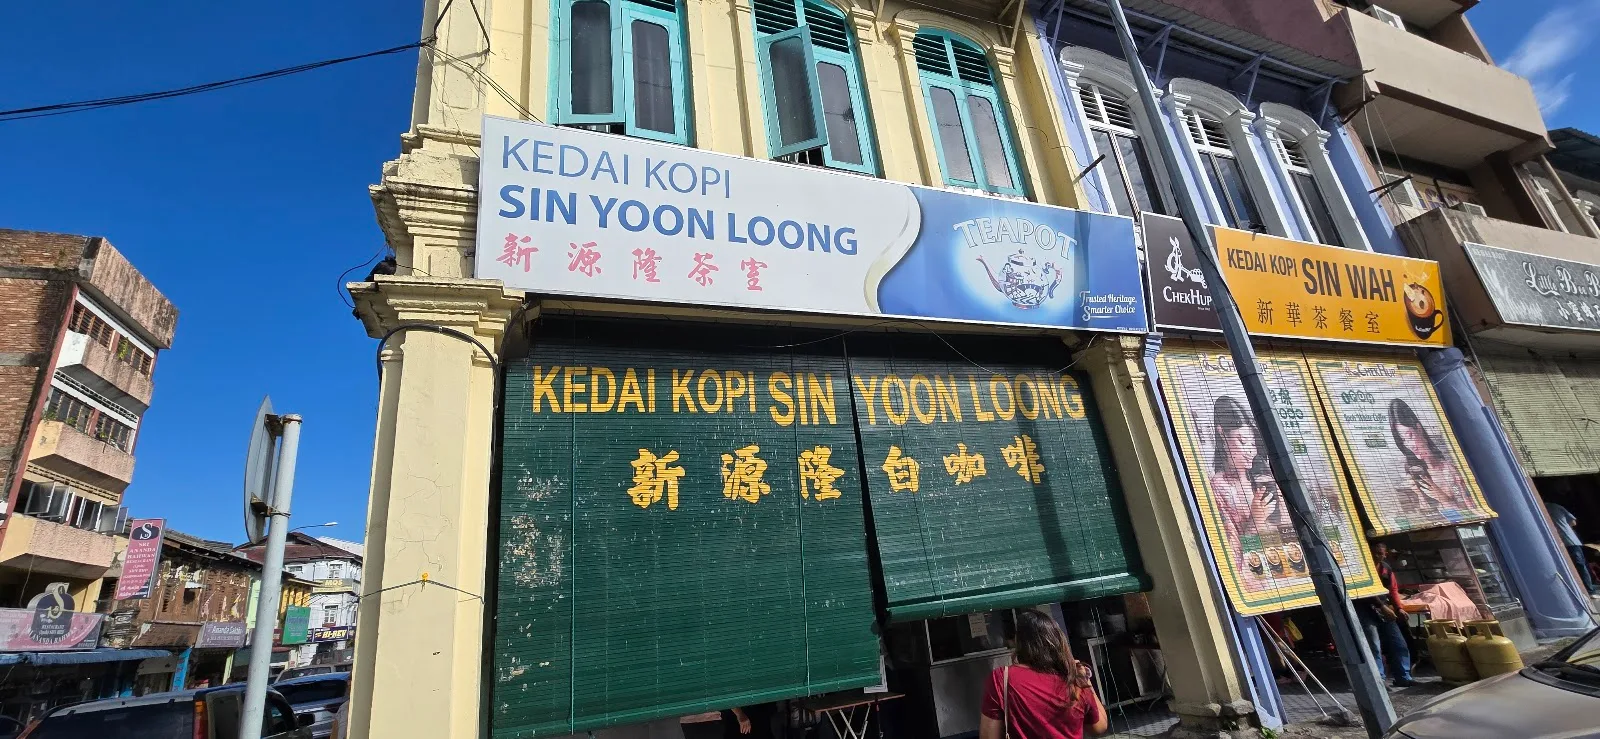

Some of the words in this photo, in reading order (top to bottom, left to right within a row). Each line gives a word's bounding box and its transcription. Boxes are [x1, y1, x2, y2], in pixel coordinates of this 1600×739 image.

[502, 135, 629, 185] KEDAI
[645, 157, 730, 199] KOPI
[498, 184, 577, 226] SIN
[589, 194, 714, 241] YOON
[728, 212, 858, 256] LOONG
[953, 216, 1078, 260] TEAPOT
[495, 232, 768, 292] 新源隆茶室
[1226, 247, 1268, 273] KEDAI
[1270, 254, 1298, 278] KOPI
[1301, 257, 1342, 298] SIN
[1344, 263, 1397, 303] WAH
[1522, 261, 1560, 297] Little
[1079, 290, 1107, 307] Trusted
[1082, 306, 1113, 321] Smarter
[1114, 304, 1136, 314] Choice
[1256, 297, 1381, 334] 新華茶餐室
[531, 364, 657, 414] KEDAI
[671, 369, 757, 414] KOPI
[768, 371, 837, 427] SIN
[852, 373, 961, 427] YOON
[969, 373, 1086, 423] LOONG
[629, 434, 1045, 511] 新源隆白咖啡
[321, 629, 348, 639] HI-REV
